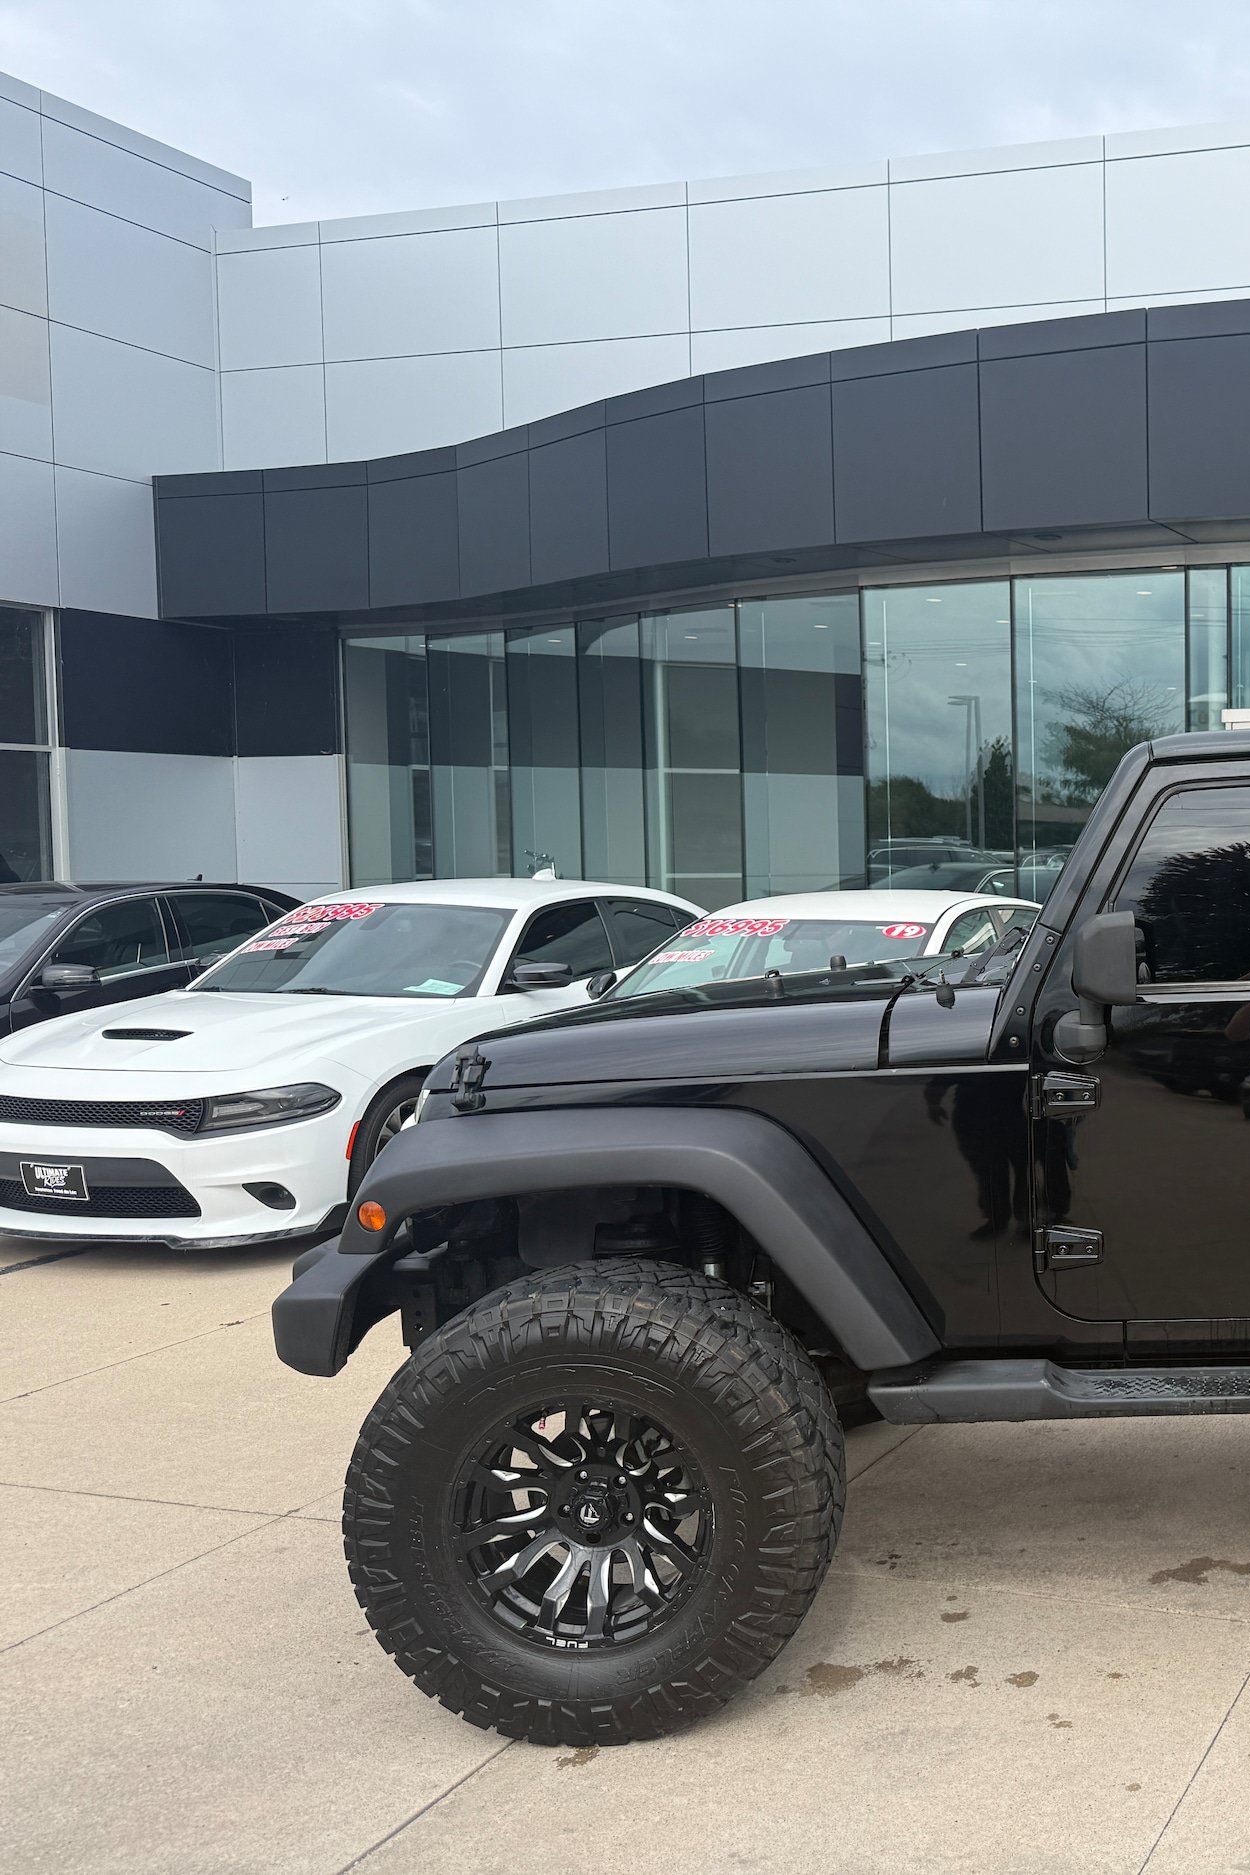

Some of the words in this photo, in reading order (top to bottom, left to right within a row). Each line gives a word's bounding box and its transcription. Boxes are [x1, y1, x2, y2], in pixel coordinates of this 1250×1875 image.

[680, 919, 790, 937] $16995
[34, 1166, 69, 1180] ULTIMATE
[44, 1176, 66, 1187] RIDES
[545, 1636, 589, 1649] FUEL
